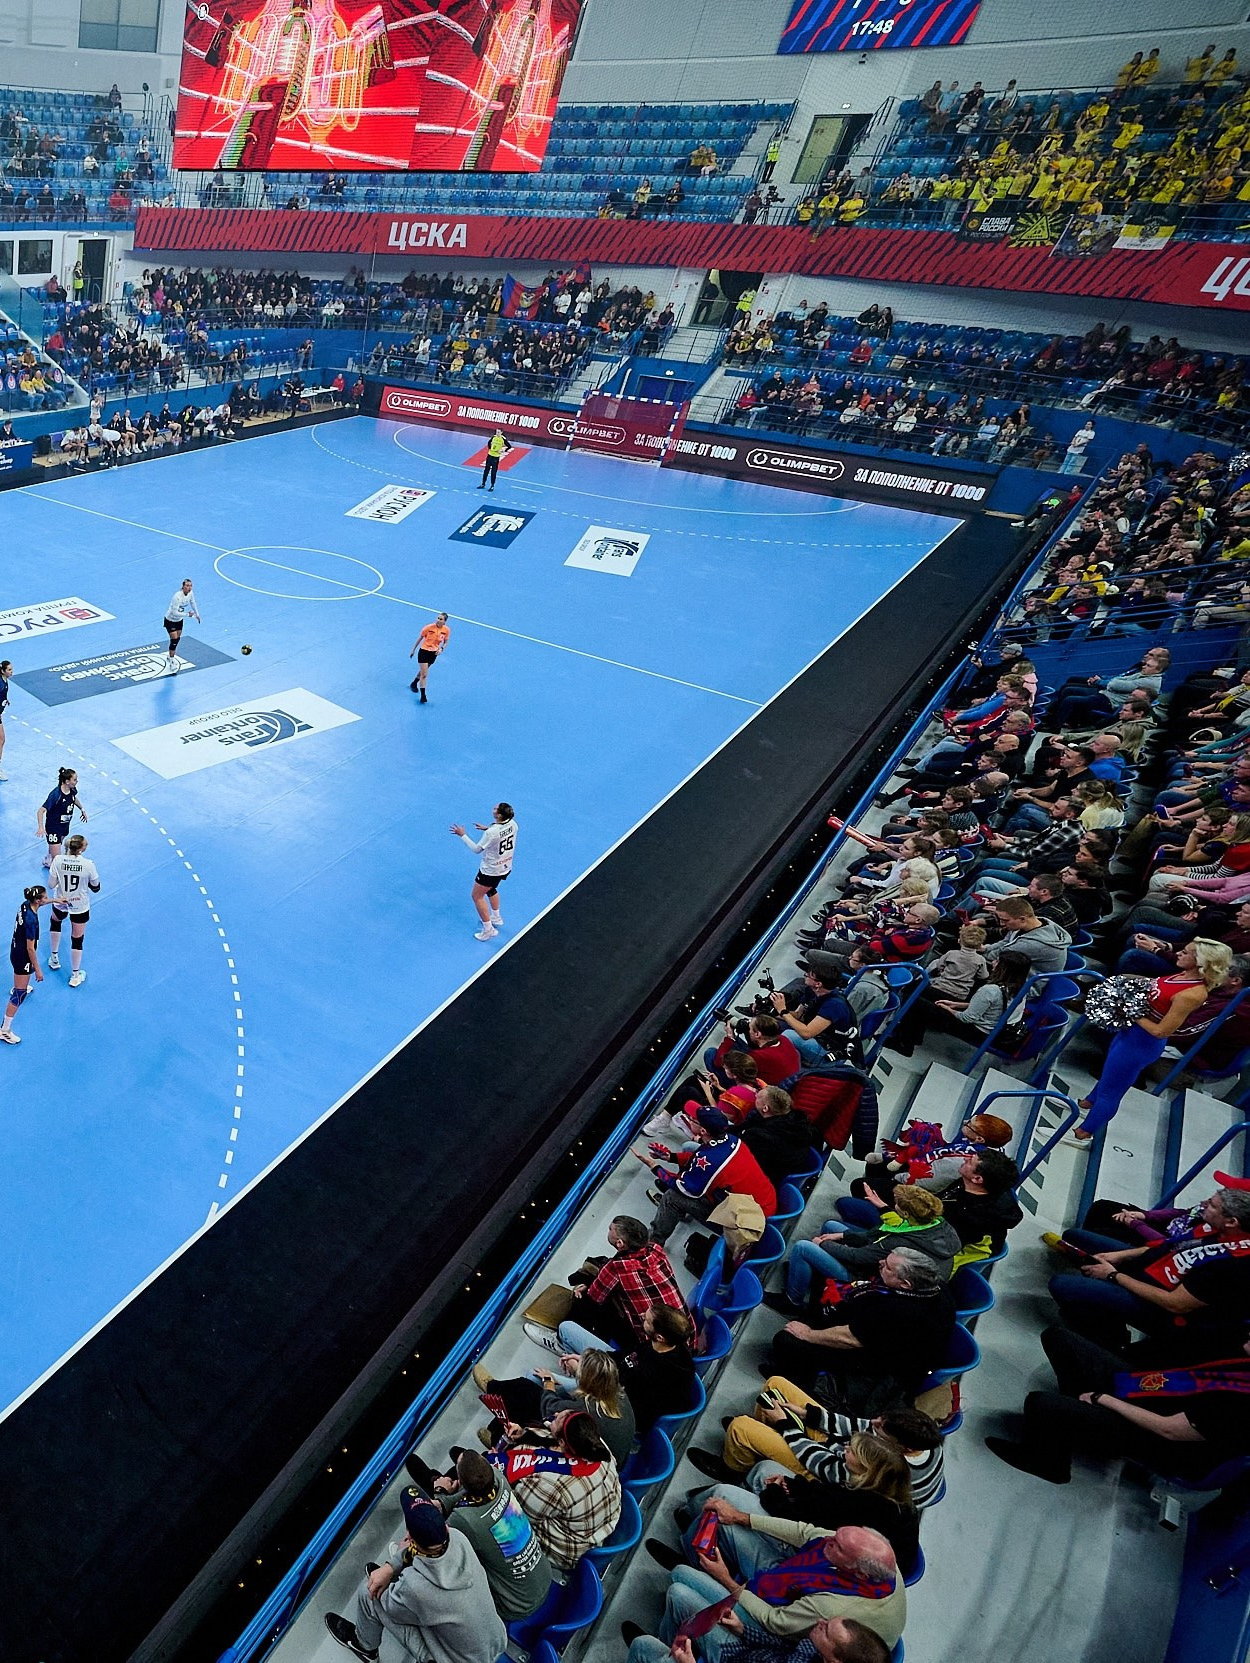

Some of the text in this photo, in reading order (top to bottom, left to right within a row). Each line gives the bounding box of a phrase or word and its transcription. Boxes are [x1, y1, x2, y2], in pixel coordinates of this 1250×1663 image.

[852, 20, 895, 35] 17:48
[388, 222, 467, 250] ЦСКА
[402, 399, 446, 412] OLIMPBET
[457, 405, 467, 417] ЗА
[508, 413, 519, 425] ОТ
[519, 415, 540, 429] 1000
[634, 433, 645, 446] ЗА
[697, 443, 712, 457] ОТ
[710, 445, 737, 461] 1000
[770, 456, 838, 475] OLIMPBET
[854, 468, 986, 501] ЗА ПОПОЛНЕНИЕ ОТ 1000
[35, 600, 77, 612] ГРУППА
[81, 650, 131, 666] КОМПАНИЙ
[188, 707, 243, 726] DELO GROUP
[48, 833, 58, 843] 86
[64, 874, 80, 893] 19
[1164, 1266, 1180, 1284] С
